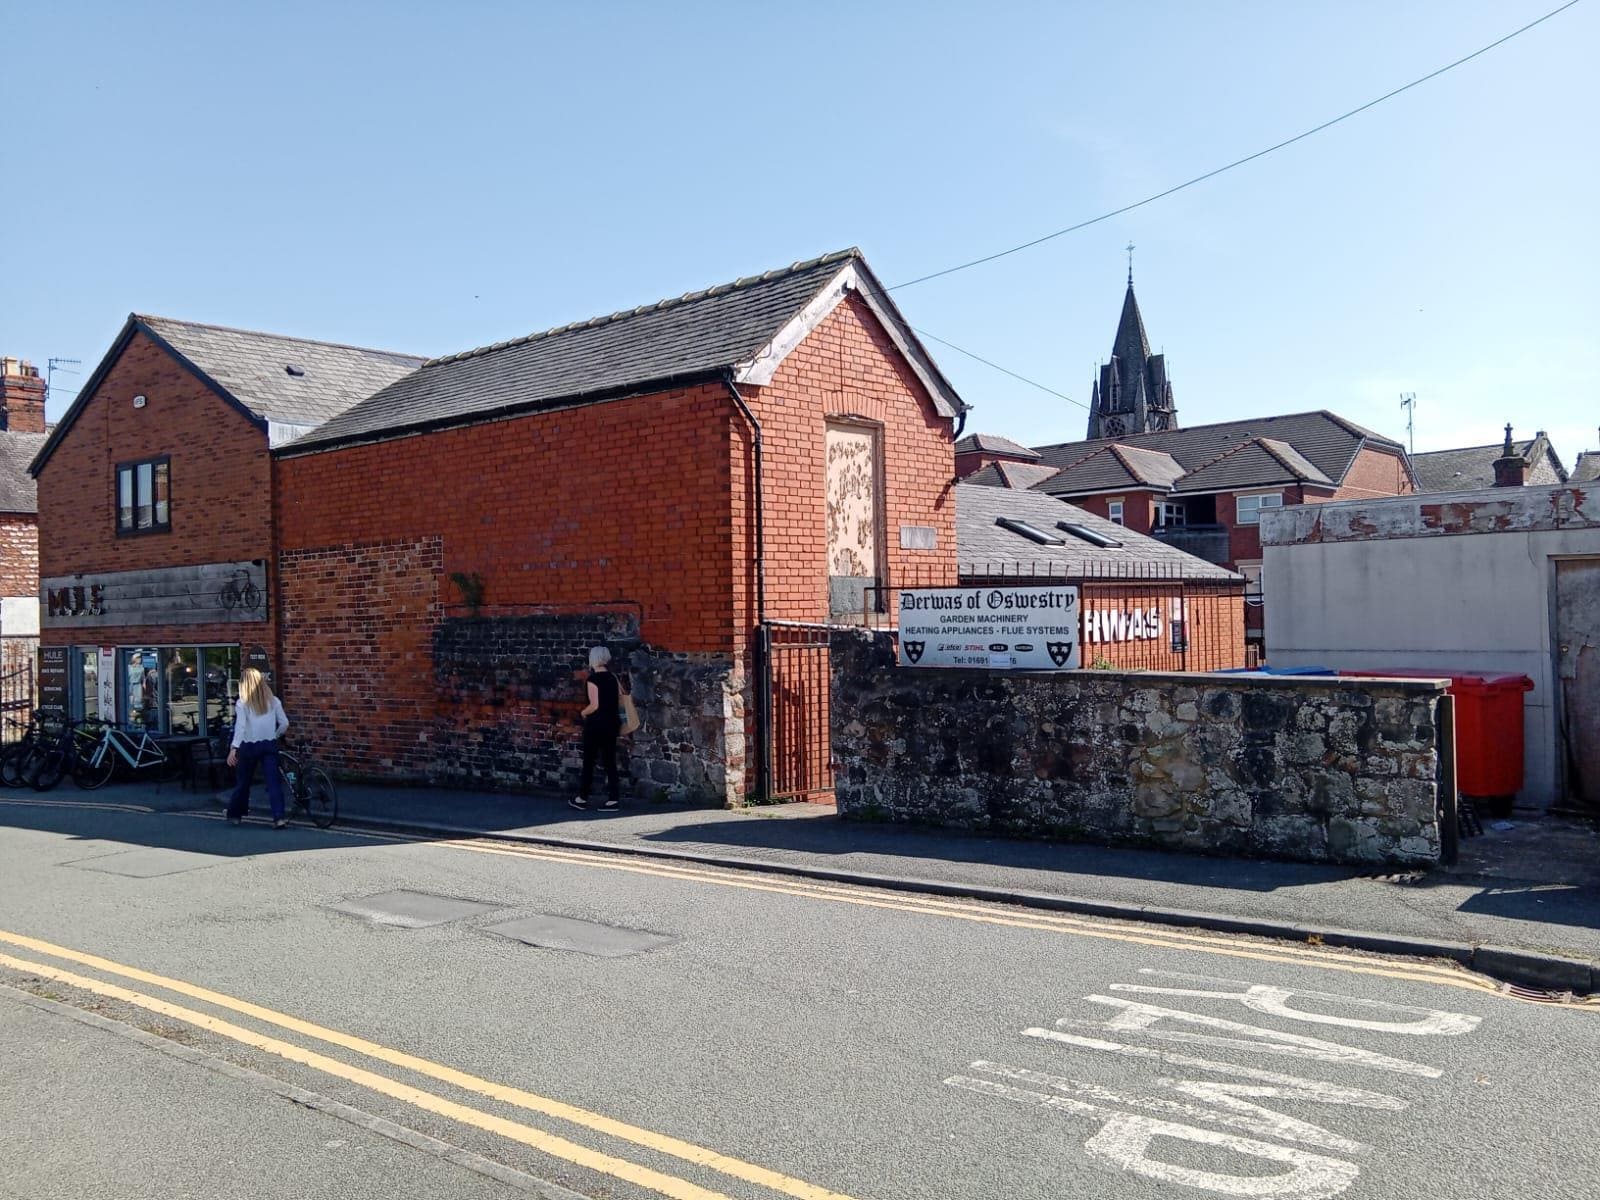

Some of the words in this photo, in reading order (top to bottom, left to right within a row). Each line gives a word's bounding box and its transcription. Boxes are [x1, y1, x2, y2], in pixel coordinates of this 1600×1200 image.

[901, 591, 962, 611] Derwas
[967, 591, 981, 610] of
[987, 590, 1075, 612] Oswestry
[940, 615, 975, 624] GARDEN
[977, 614, 1029, 624] MACHINERY
[1077, 607, 1163, 643] RWAS
[905, 627, 940, 635] HEATING
[941, 627, 994, 635] APPLIANCES
[1001, 627, 1026, 635] FLUE
[1026, 626, 1069, 635] SYSTEMS
[954, 656, 966, 664] Tel:
[968, 656, 989, 665] 01691
[943, 968, 1483, 1199] RAMP
